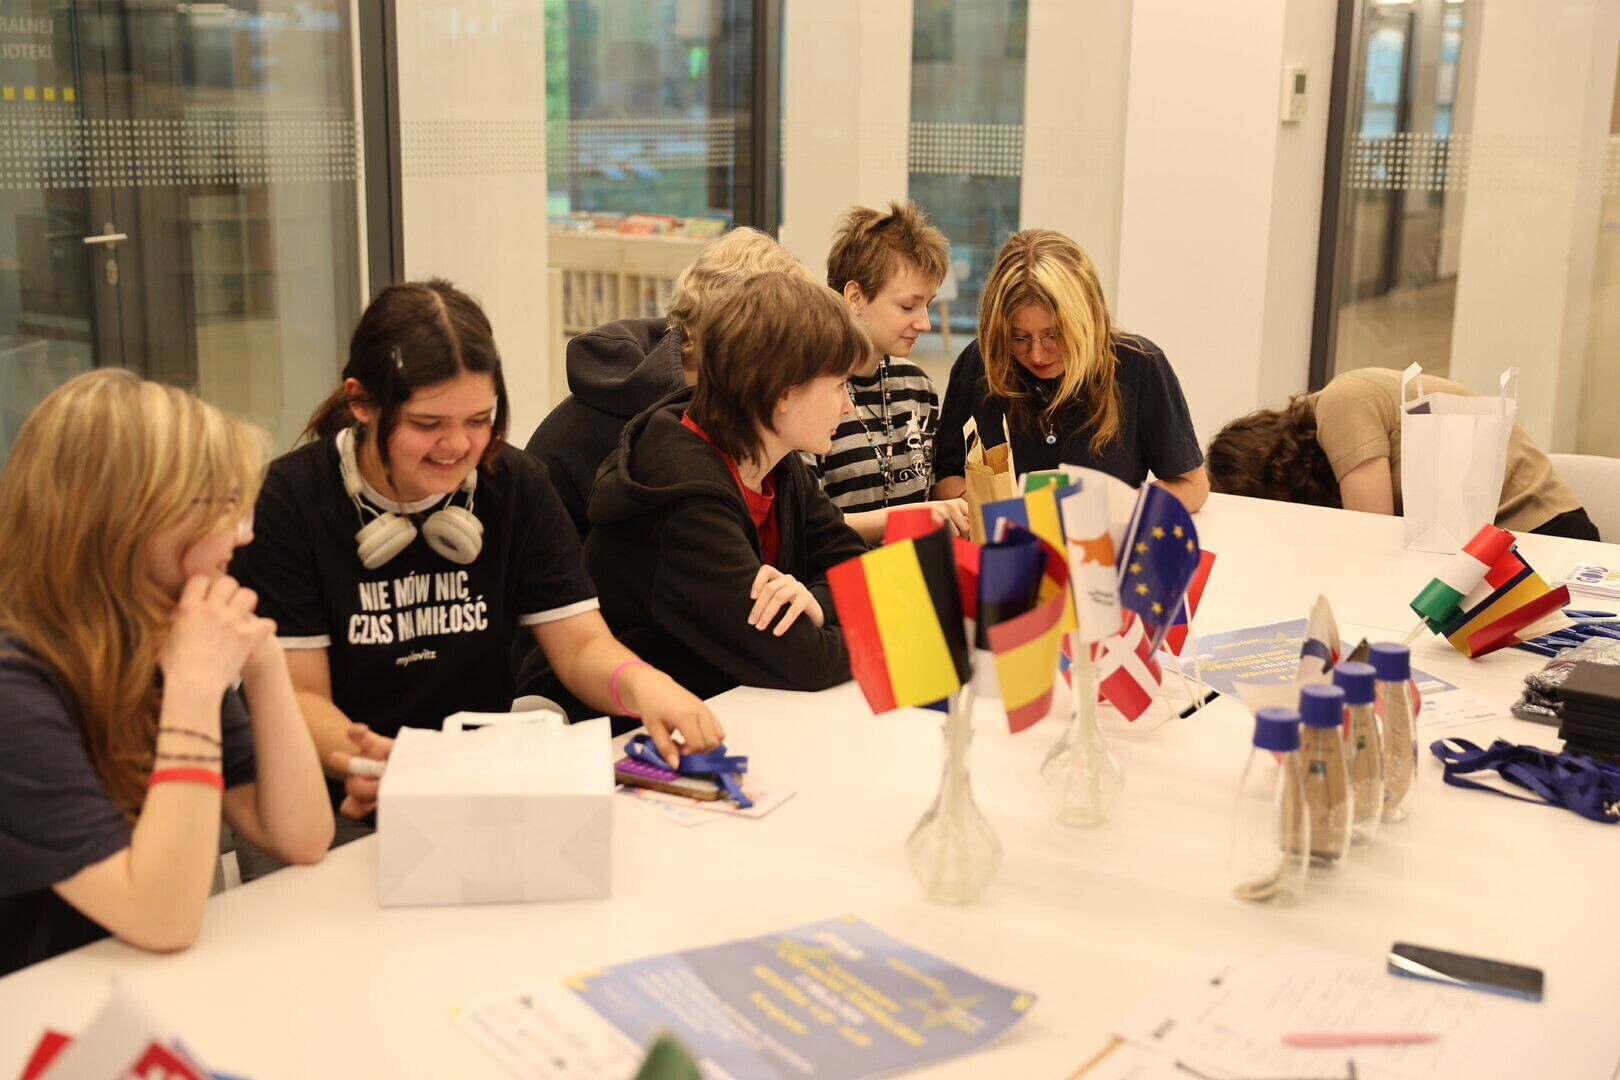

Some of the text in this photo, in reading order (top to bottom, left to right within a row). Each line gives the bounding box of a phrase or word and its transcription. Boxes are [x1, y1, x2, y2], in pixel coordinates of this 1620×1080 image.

[0, 43, 52, 59] IOTEKI
[358, 570, 469, 611] NIE MÓW NIC
[348, 595, 488, 645] CZAS NA MIŁOŚĆ
